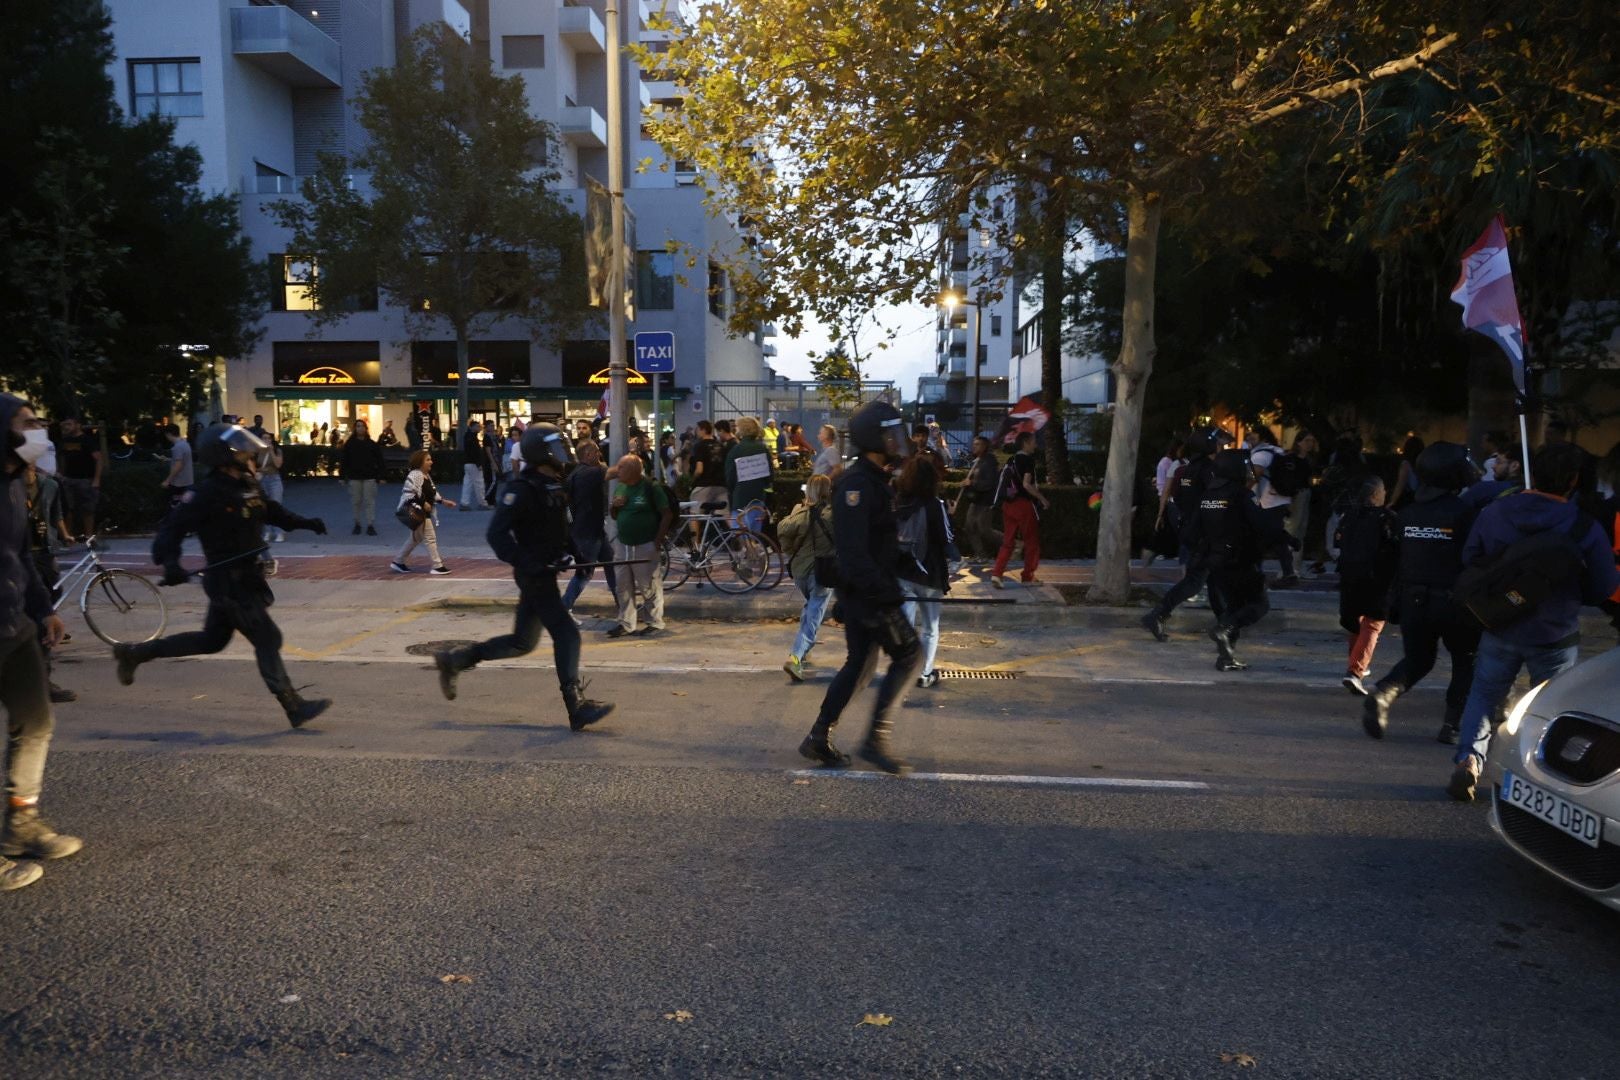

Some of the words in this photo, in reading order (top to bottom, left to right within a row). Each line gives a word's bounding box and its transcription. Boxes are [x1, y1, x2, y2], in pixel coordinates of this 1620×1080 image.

[638, 346, 672, 359] TAXI
[298, 374, 327, 384] Arena
[328, 373, 354, 384] Zone
[588, 374, 612, 384] Aren
[626, 376, 646, 384] one
[421, 415, 430, 452] ineken
[1404, 532, 1452, 540] NACIONAL
[1512, 779, 1555, 820] 6282
[1559, 802, 1597, 841] DBD
